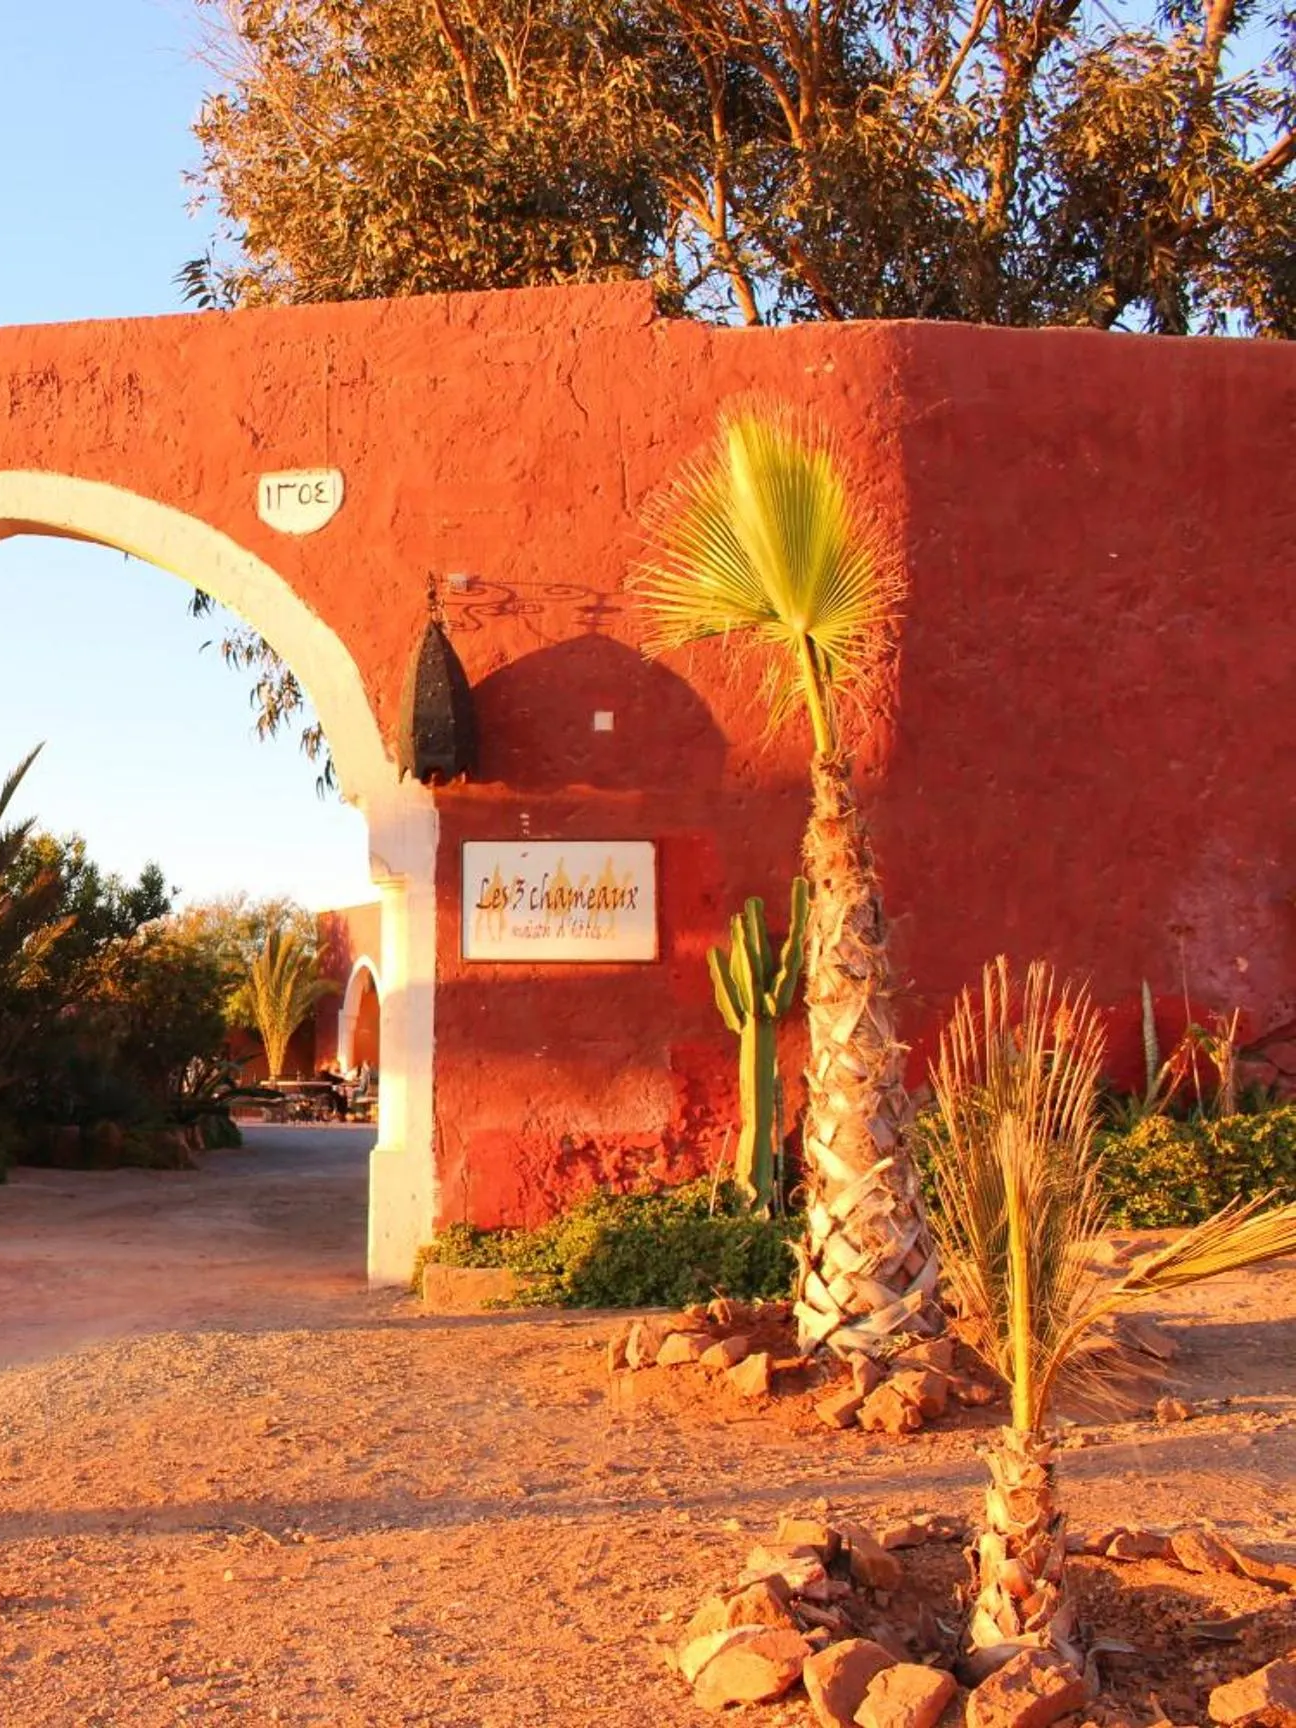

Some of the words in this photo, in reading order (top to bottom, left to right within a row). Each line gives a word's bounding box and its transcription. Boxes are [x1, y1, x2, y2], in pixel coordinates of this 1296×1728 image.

[476, 877, 510, 910] Les
[512, 878, 526, 910] 3
[529, 872, 639, 912] chameaux
